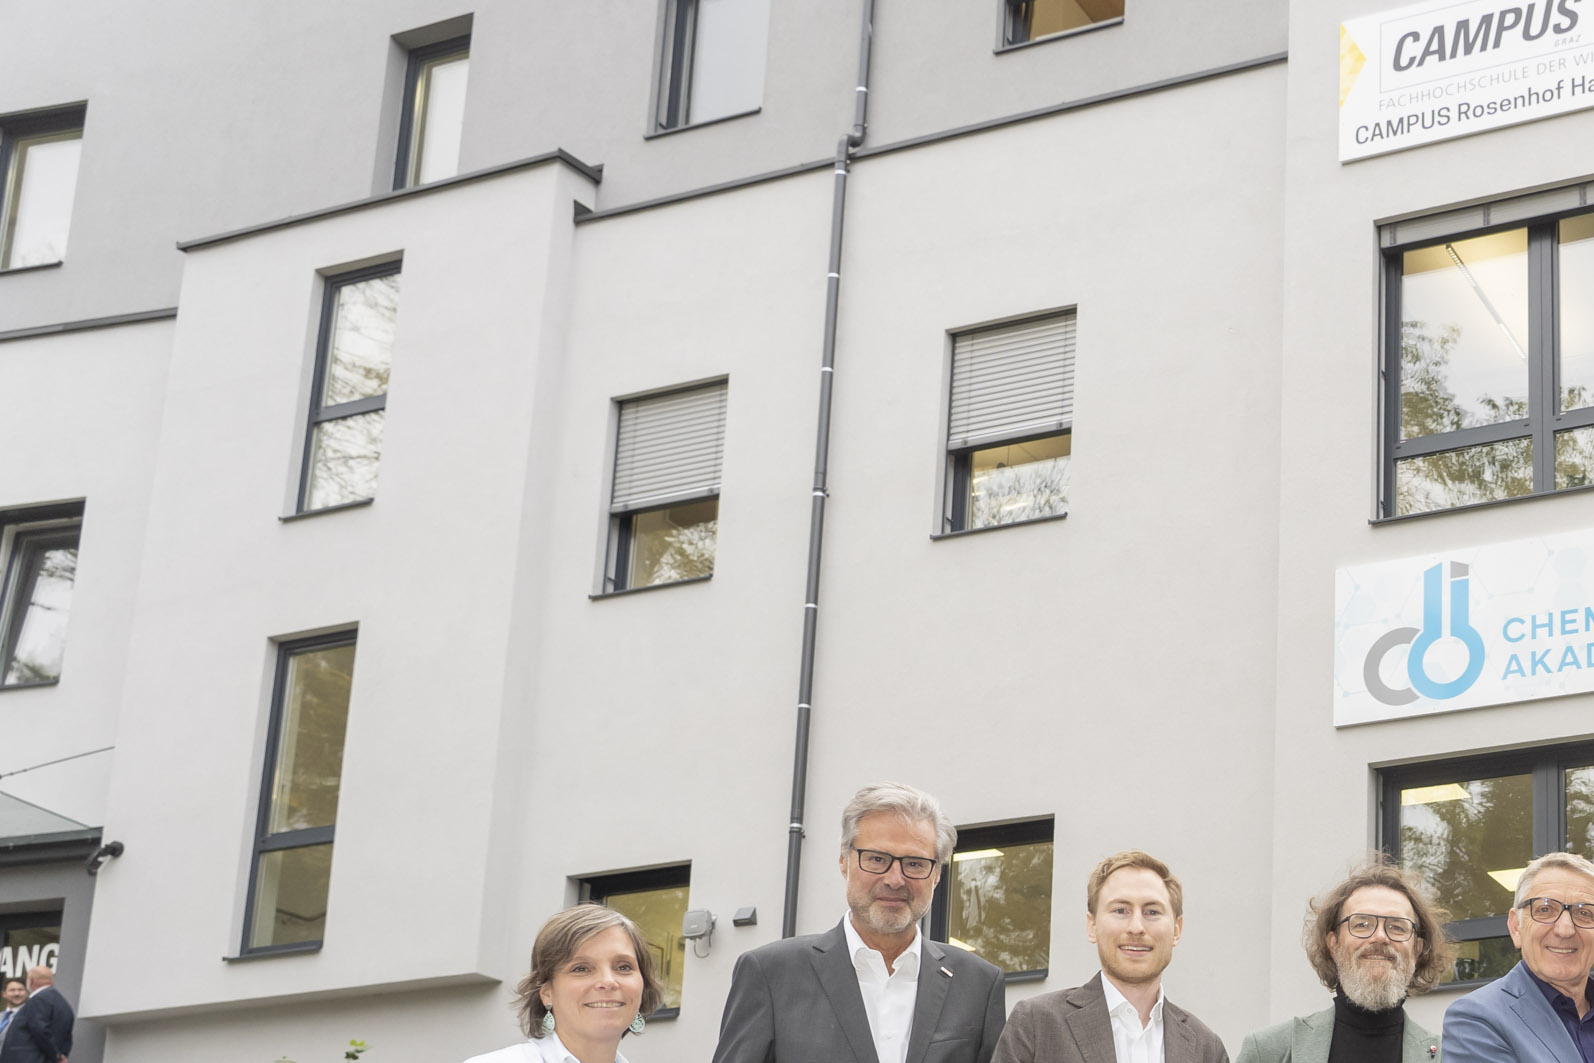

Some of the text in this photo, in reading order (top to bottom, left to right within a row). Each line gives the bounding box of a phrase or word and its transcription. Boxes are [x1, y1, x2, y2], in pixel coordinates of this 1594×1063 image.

[1393, 0, 1583, 72] CAMPUS
[1554, 34, 1582, 48] GRAZ
[1355, 106, 1451, 145] CAMPUS
[1457, 79, 1564, 122] Rosenhof
[1378, 66, 1529, 112] FACHHOCHSCHULE
[1536, 57, 1567, 75] DER
